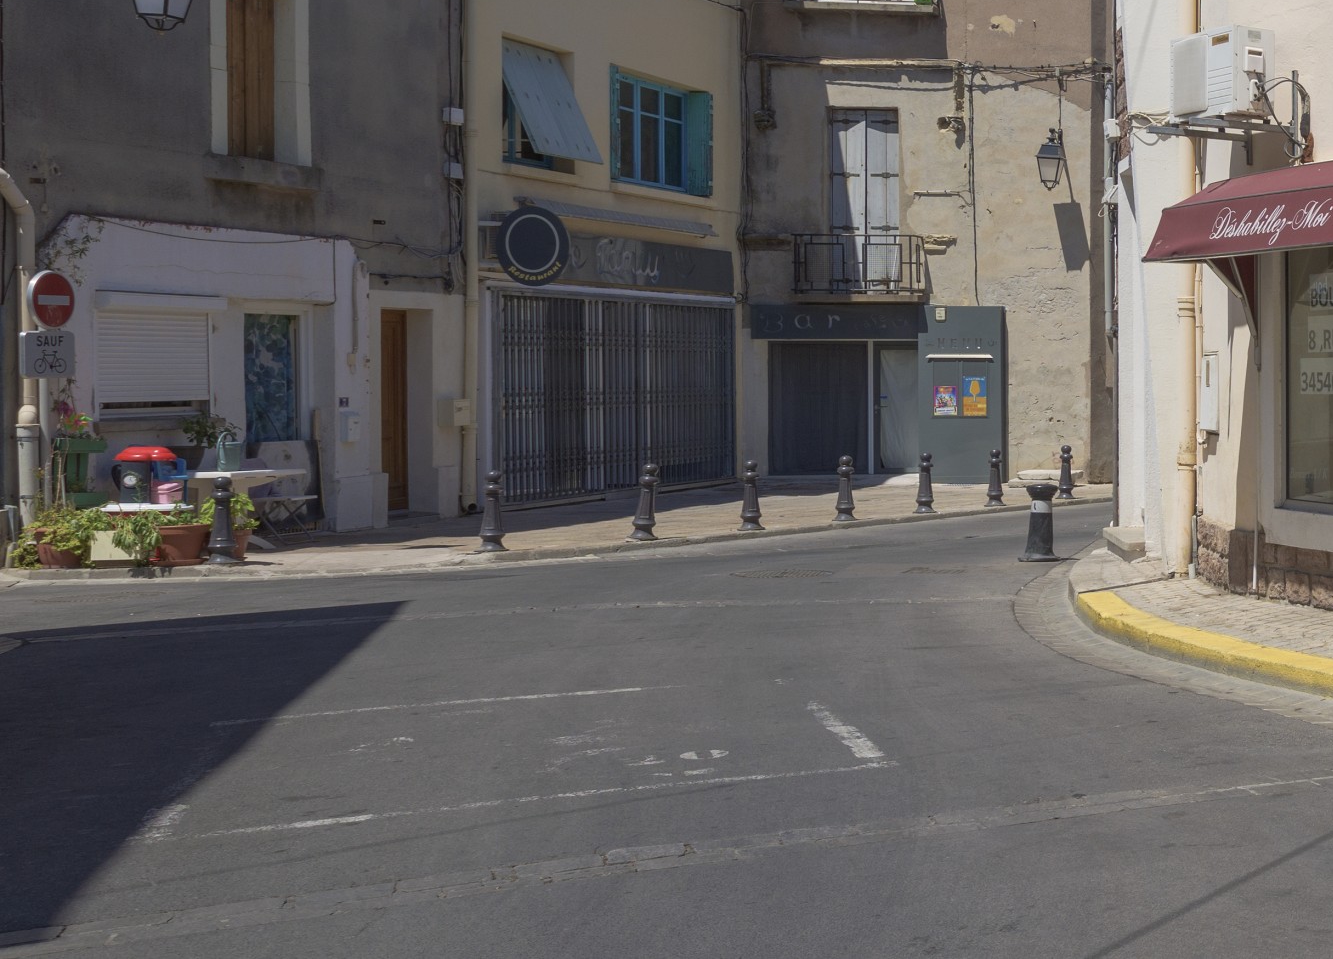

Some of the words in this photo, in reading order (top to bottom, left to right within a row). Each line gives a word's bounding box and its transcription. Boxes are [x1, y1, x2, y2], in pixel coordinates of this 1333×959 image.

[1209, 198, 1332, 245] Déshabillez-Moi
[508, 261, 562, 281] Restaurant
[760, 313, 841, 333] Bar
[36, 335, 64, 347] SAUF
[1308, 330, 1316, 350] 8
